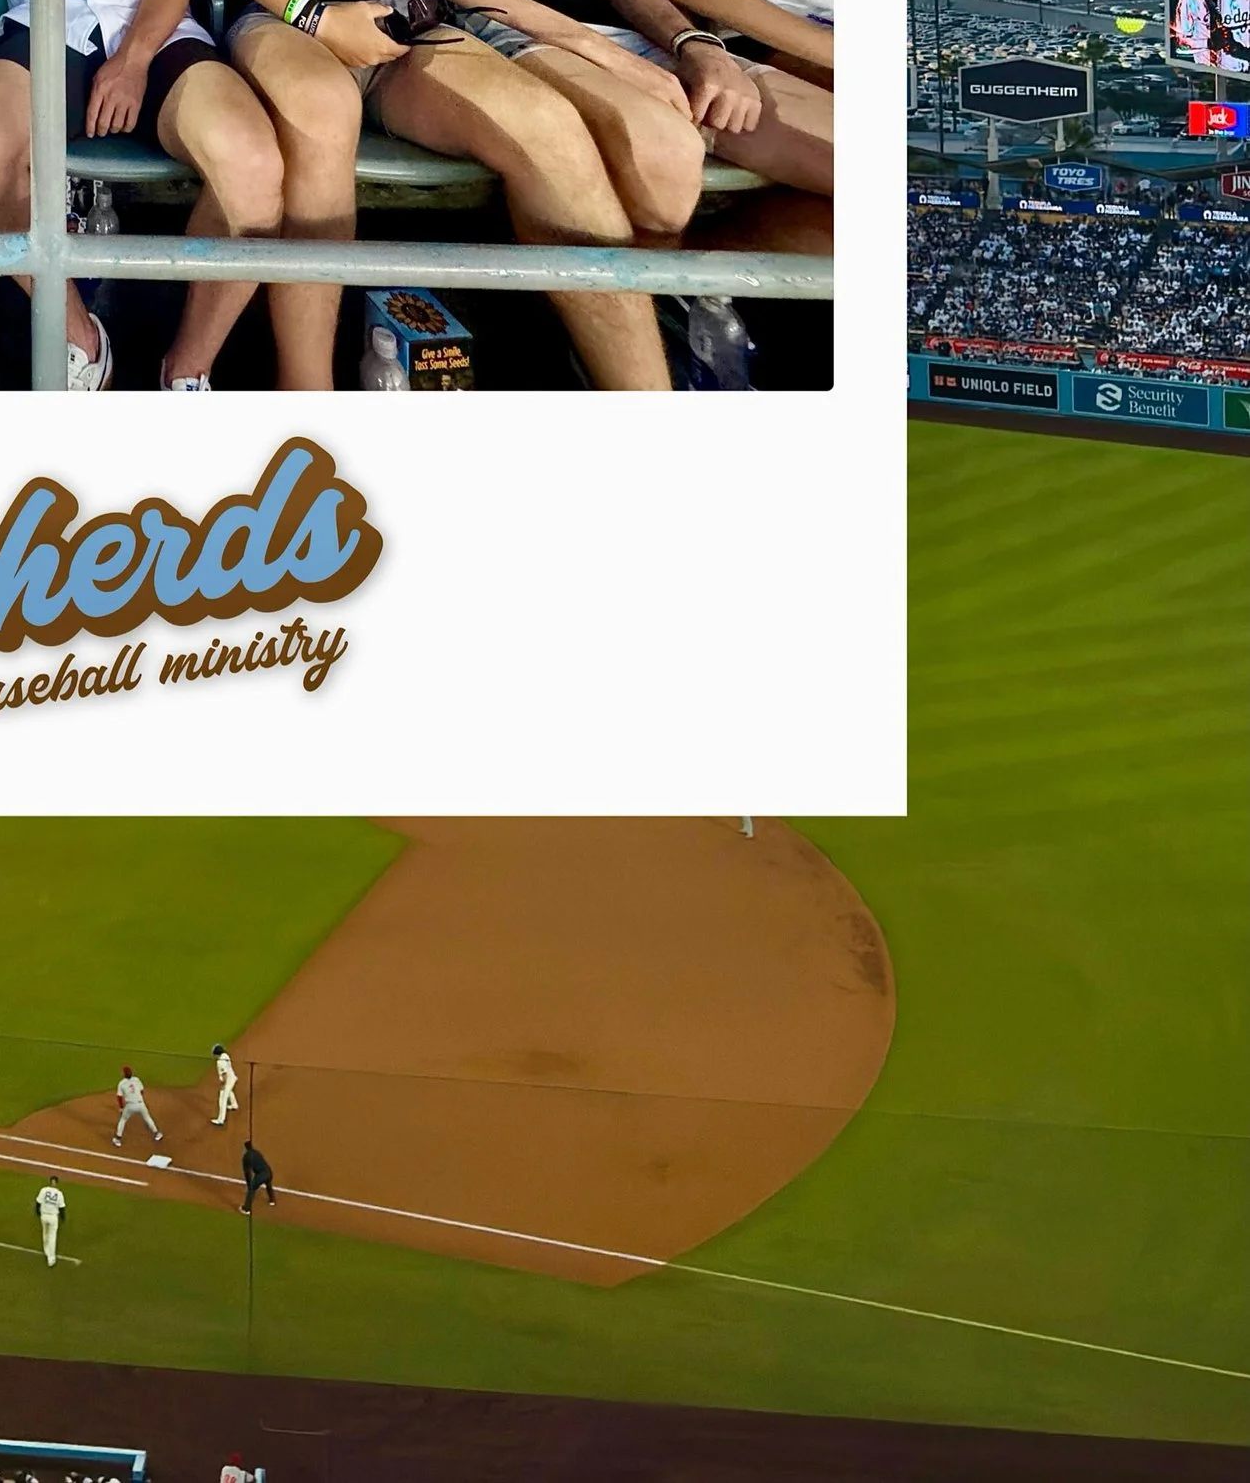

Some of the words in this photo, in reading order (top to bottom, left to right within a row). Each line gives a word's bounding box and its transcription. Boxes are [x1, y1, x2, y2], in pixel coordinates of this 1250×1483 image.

[970, 84, 1079, 97] GUGGENHEIM
[1052, 167, 1086, 177] TOYO
[1057, 176, 1094, 186] TIRES
[422, 348, 435, 359] Give
[414, 360, 428, 371] Toss
[430, 359, 447, 371] Some
[449, 356, 470, 368] Seeds!
[961, 377, 1009, 393] UNIQLO
[1013, 383, 1053, 397] FIELD
[1128, 386, 1184, 406] Security
[1129, 400, 1176, 417] Benefit
